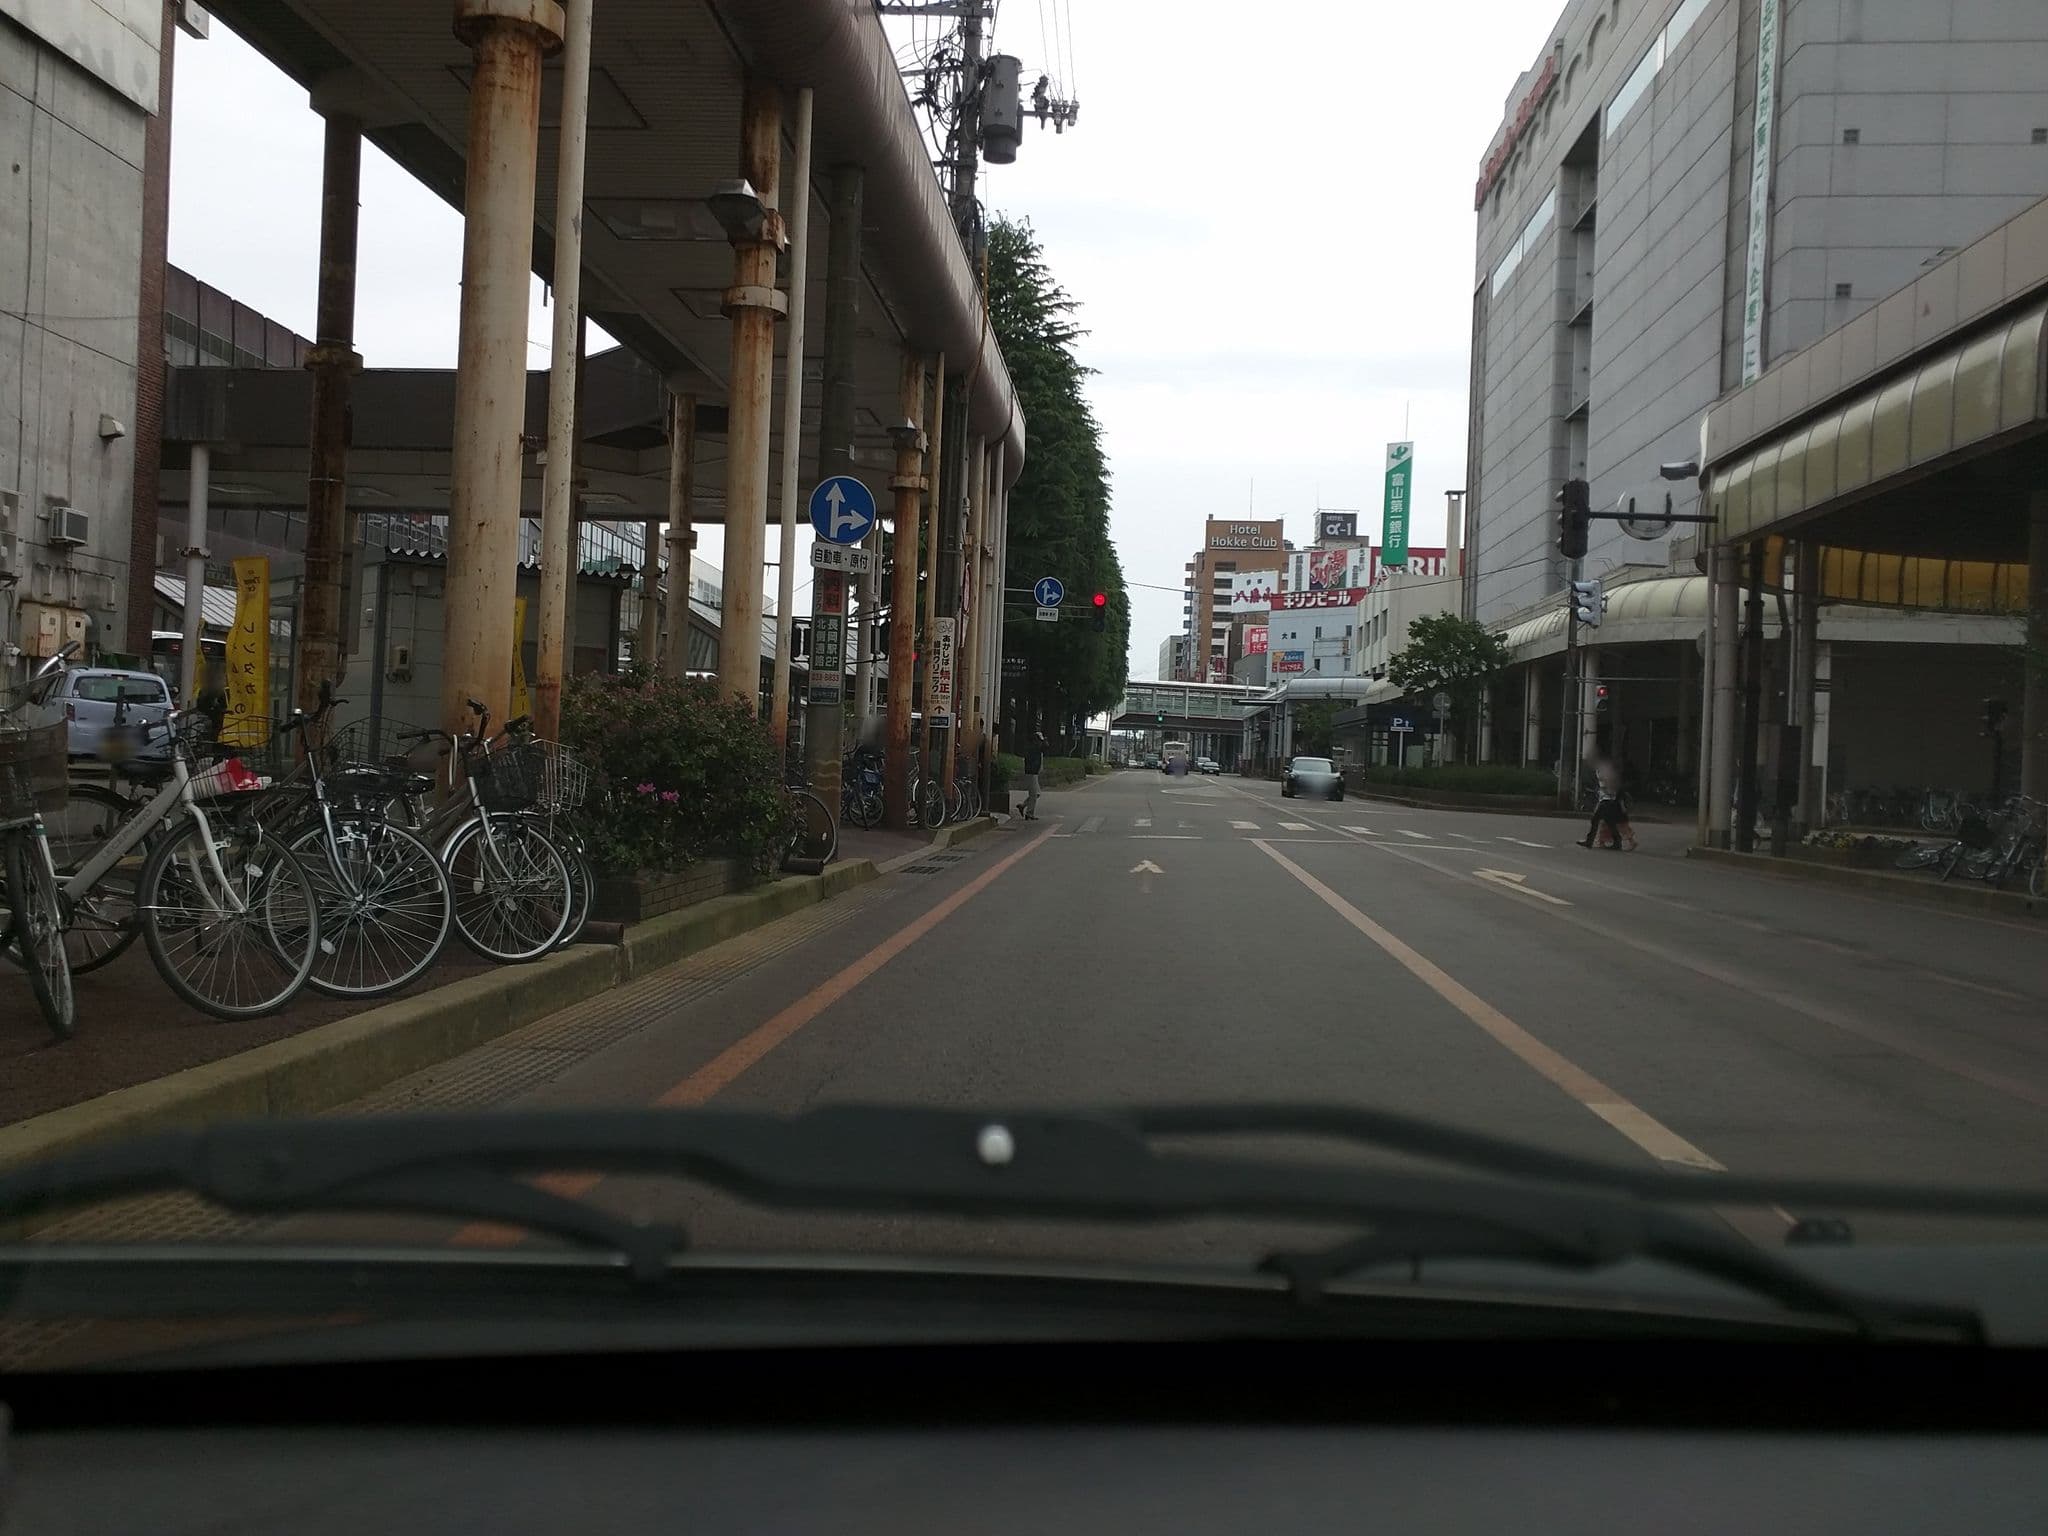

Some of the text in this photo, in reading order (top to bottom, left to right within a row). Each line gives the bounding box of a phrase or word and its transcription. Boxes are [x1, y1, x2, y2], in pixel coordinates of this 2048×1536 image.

[1389, 473, 1405, 548] 富山第一銀行
[1230, 524, 1261, 535] Hotel
[1211, 536, 1278, 547] Hokke Club
[815, 548, 868, 570] 自動車・原付
[1283, 590, 1351, 609] キリンビール
